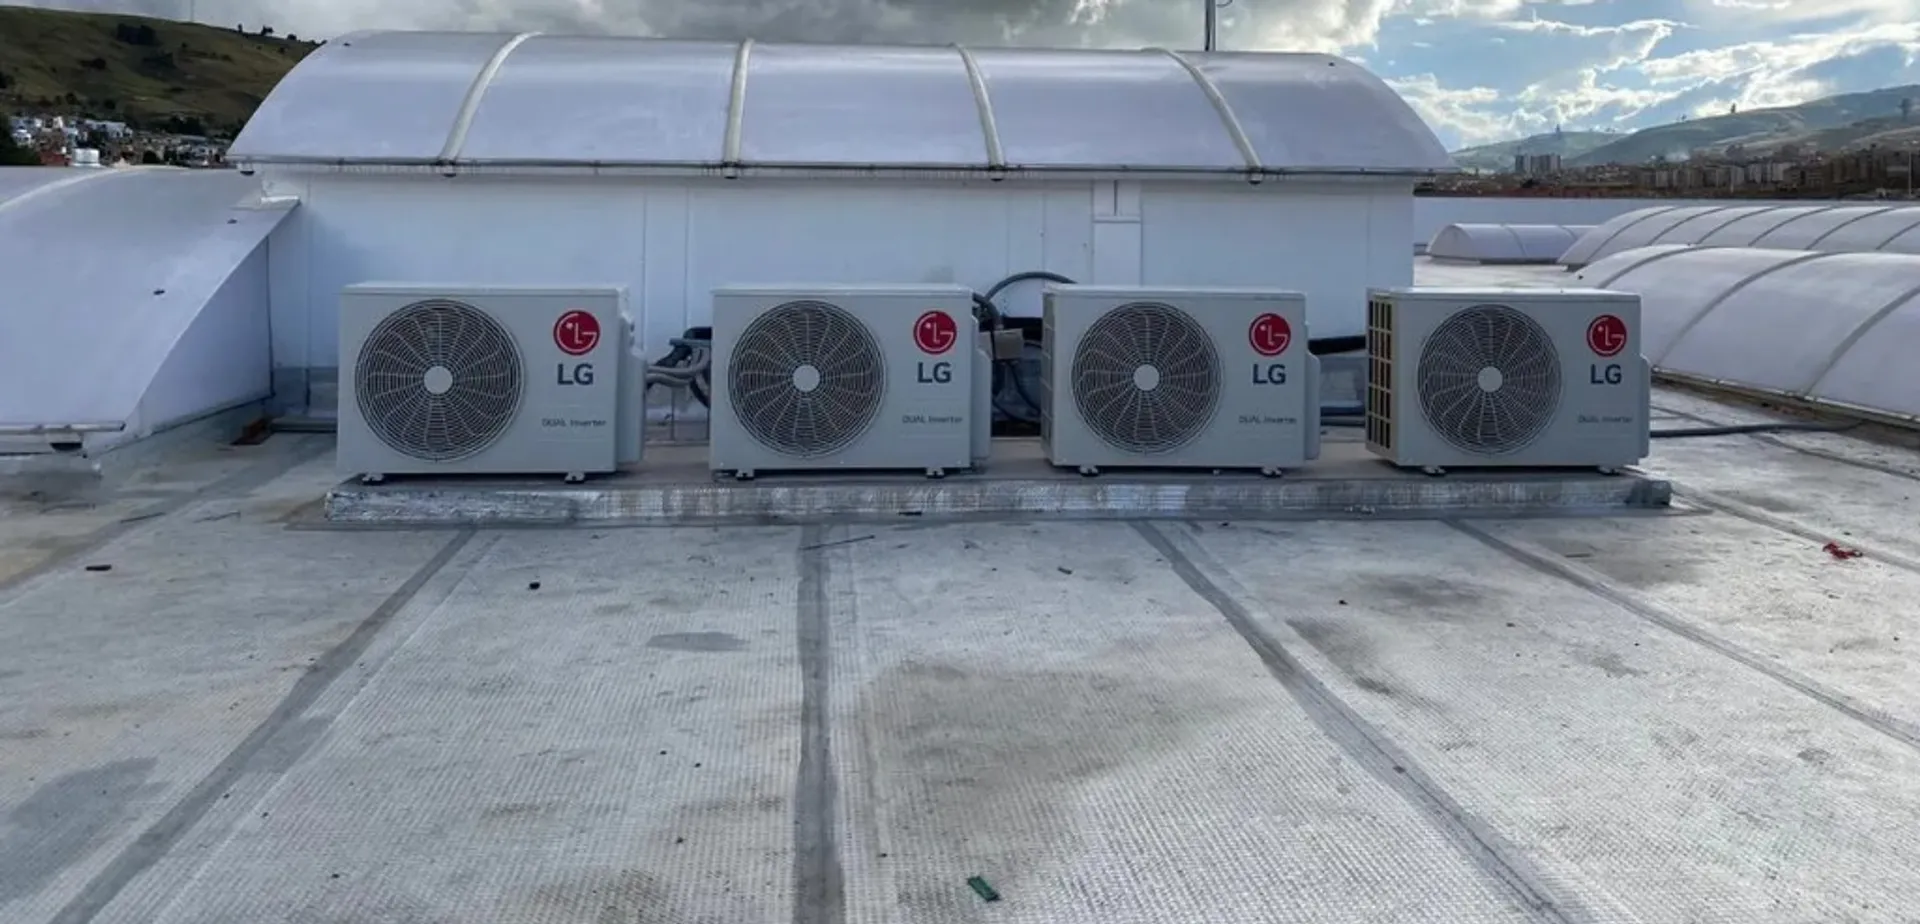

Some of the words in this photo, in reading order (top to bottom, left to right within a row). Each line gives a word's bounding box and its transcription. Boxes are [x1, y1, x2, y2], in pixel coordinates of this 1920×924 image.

[557, 363, 594, 386] LG
[917, 362, 952, 384] LG
[1252, 363, 1286, 385] LG
[1590, 364, 1622, 385] LG
